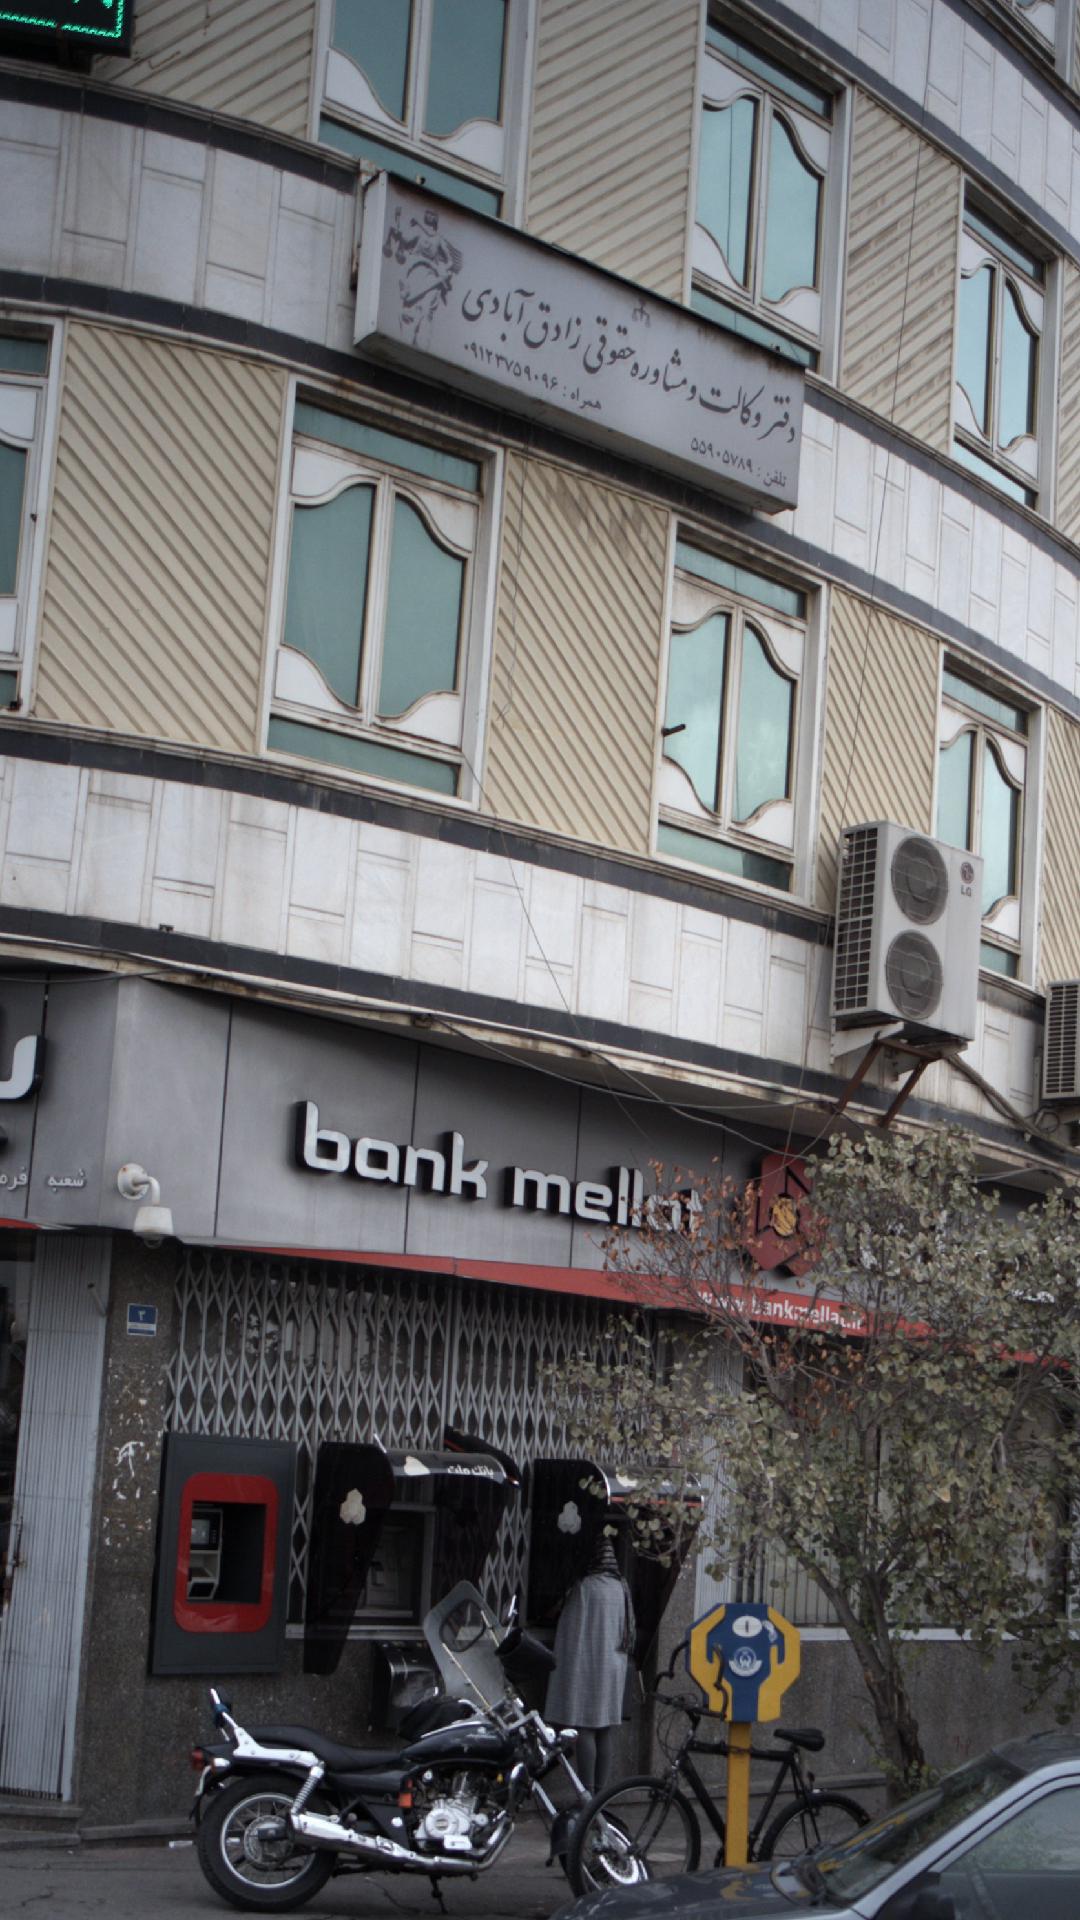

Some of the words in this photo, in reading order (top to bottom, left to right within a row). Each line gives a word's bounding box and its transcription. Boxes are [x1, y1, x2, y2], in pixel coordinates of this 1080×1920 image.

[461, 288, 536, 342] آبادی
[582, 315, 636, 375] حقوقی
[629, 347, 688, 392] مشاوره
[757, 395, 796, 443] دفتر
[47, 1167, 85, 1192] شعبه
[299, 1100, 489, 1199] bank
[509, 1165, 704, 1235] mellat
